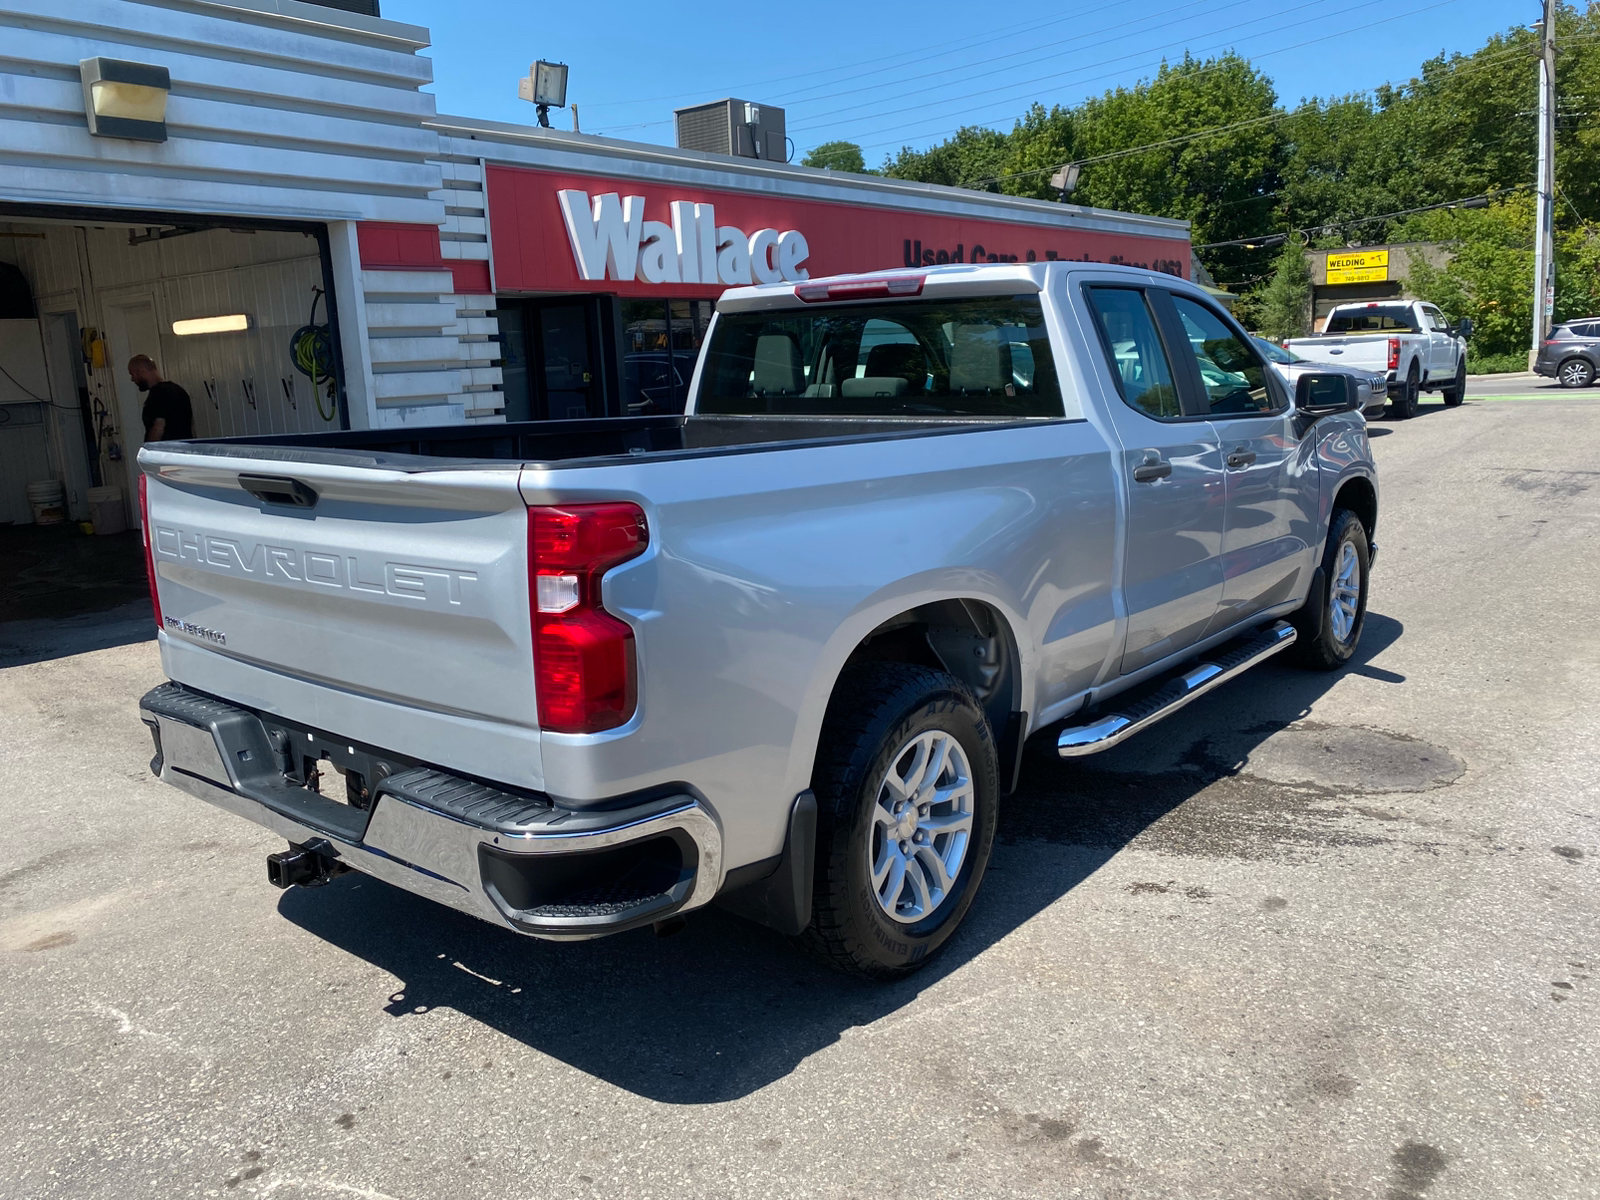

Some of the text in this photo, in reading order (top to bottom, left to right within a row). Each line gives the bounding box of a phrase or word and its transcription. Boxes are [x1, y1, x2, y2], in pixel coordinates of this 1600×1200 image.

[557, 188, 810, 285] Wallace
[903, 239, 964, 267] Used
[1329, 259, 1365, 267] WELDING
[156, 525, 478, 605] CHEVROLET
[924, 699, 961, 717] A/T
